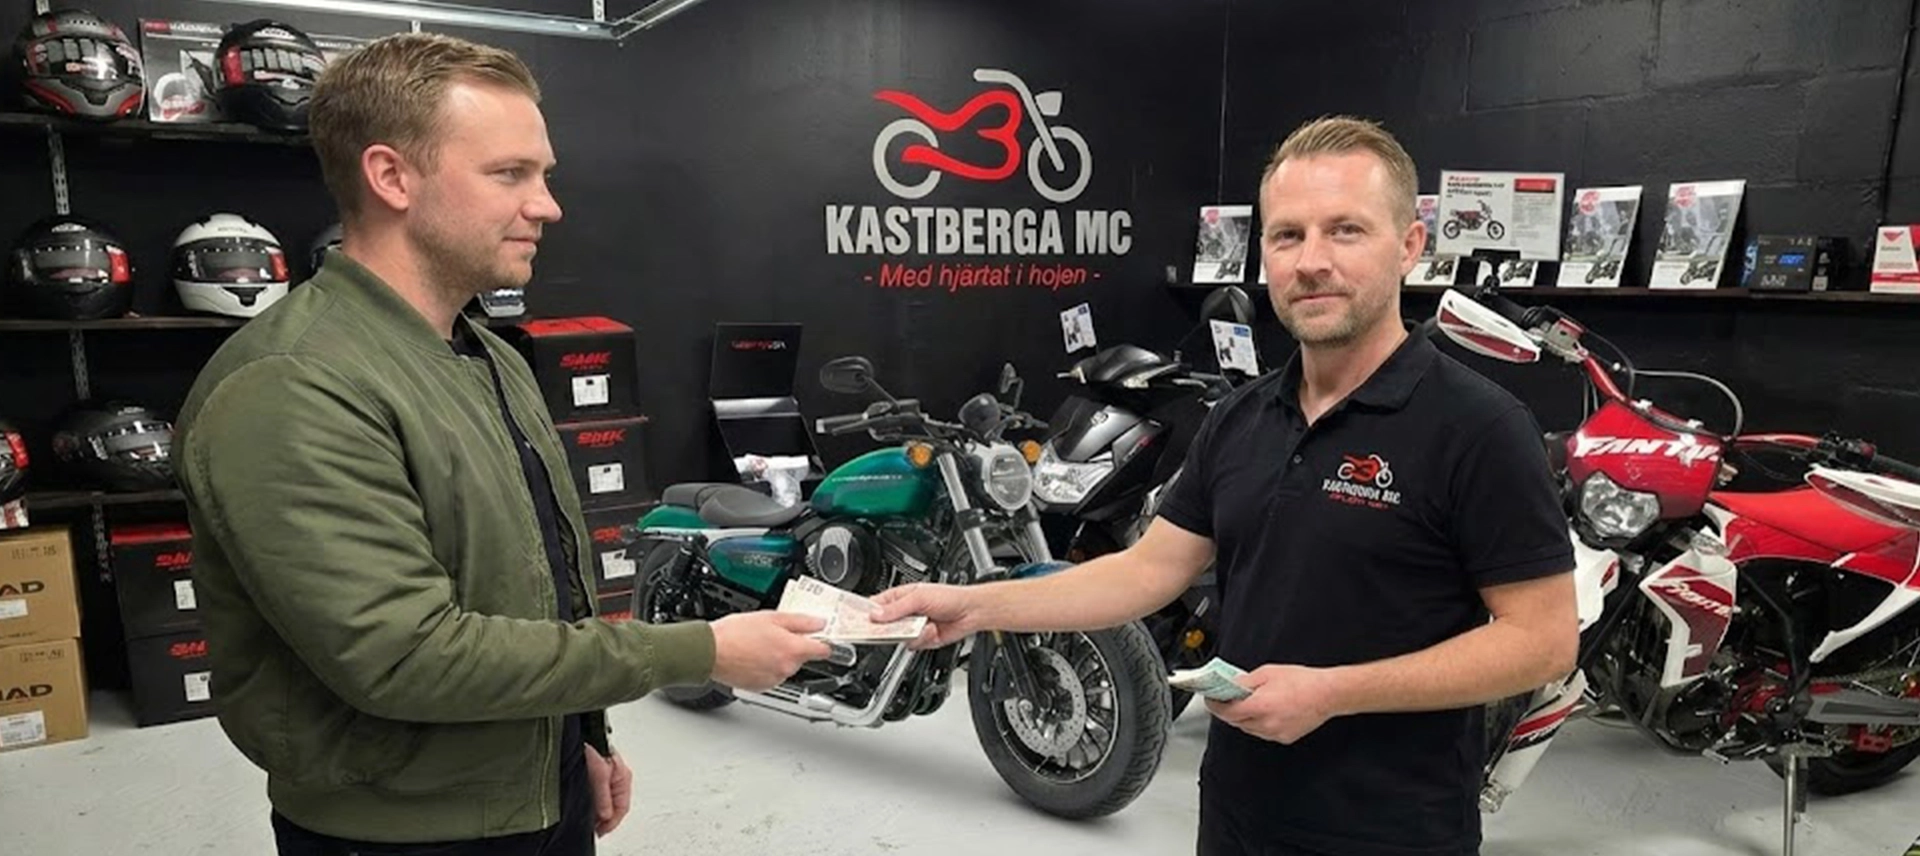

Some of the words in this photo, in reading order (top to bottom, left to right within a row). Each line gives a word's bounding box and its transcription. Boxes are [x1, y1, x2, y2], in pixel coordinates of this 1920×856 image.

[826, 205, 1064, 256] KASTBERGA
[1075, 210, 1132, 255] MC
[879, 263, 932, 288] Med
[939, 263, 1011, 292] hjärtat
[1016, 264, 1023, 285] i
[1029, 264, 1086, 291] hojen
